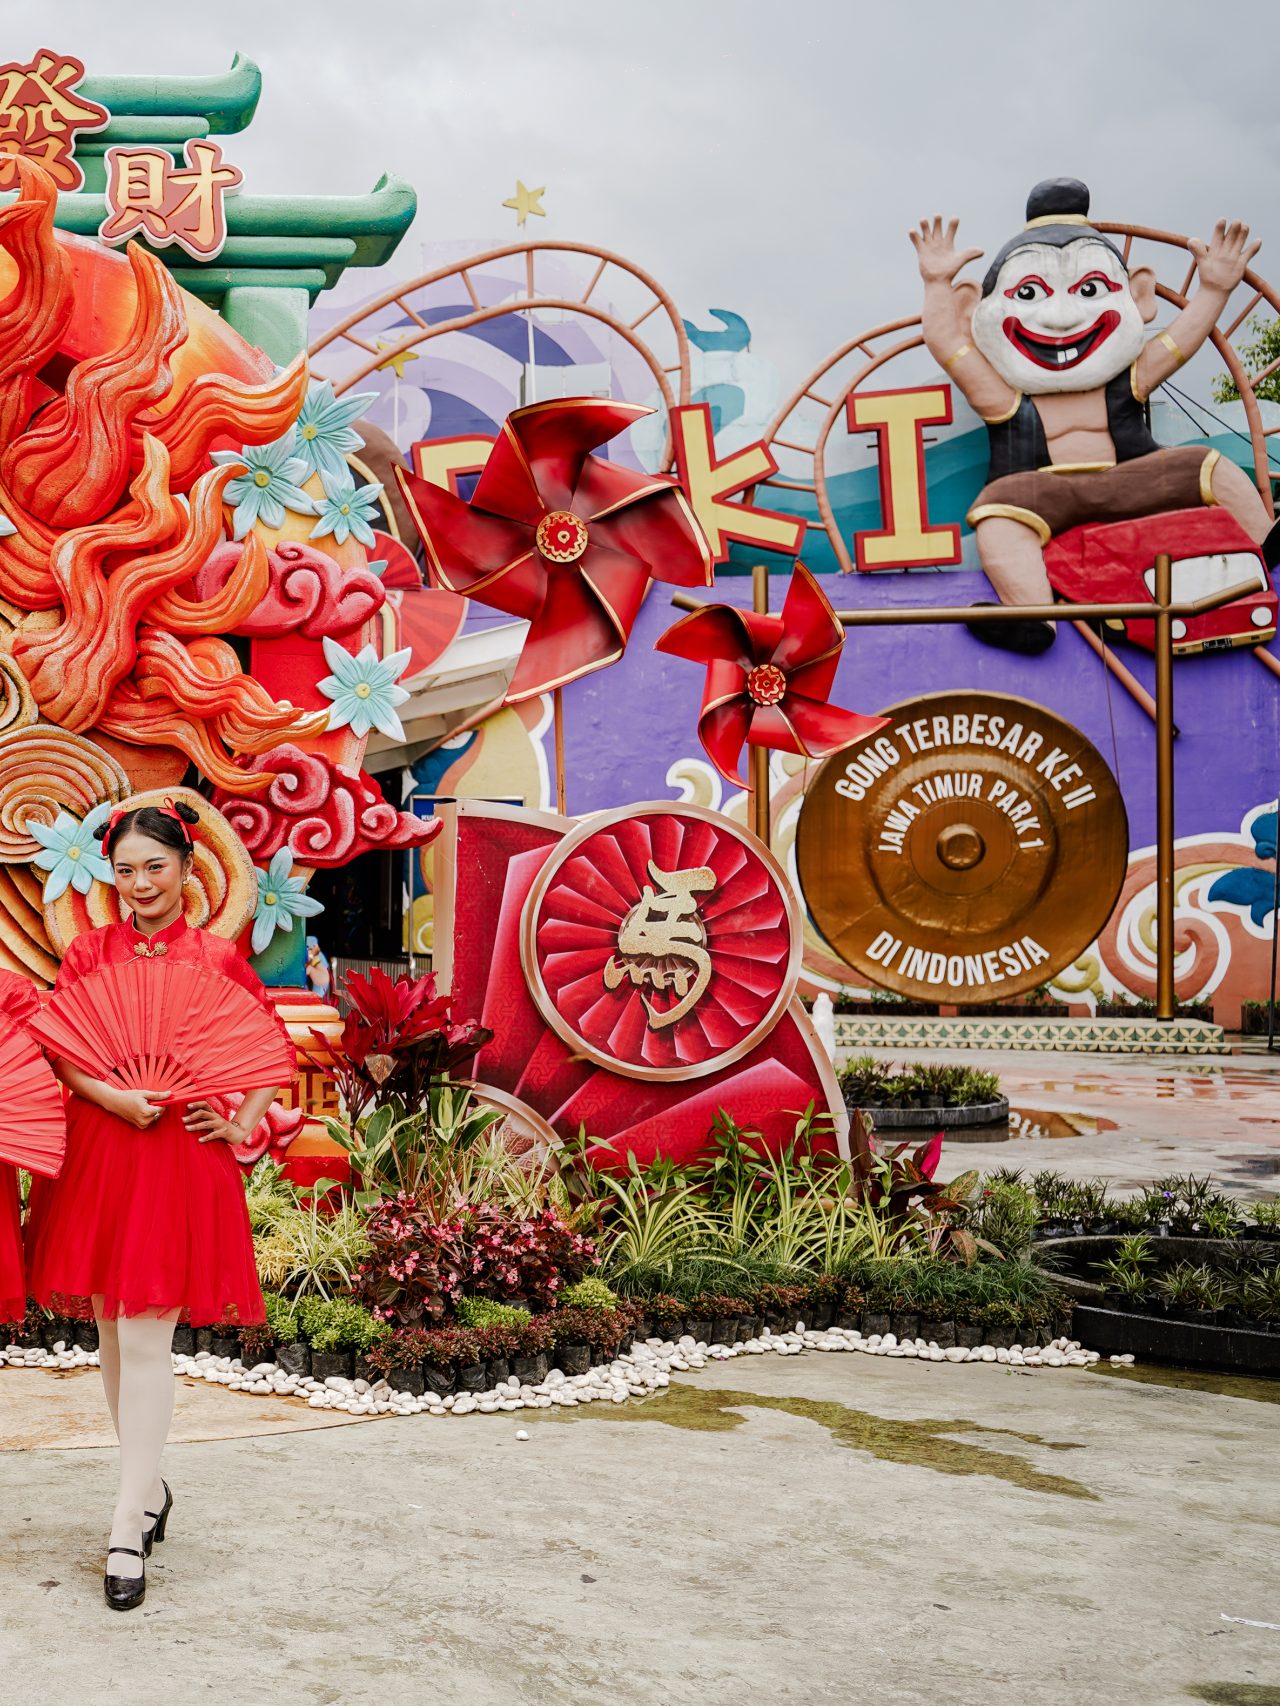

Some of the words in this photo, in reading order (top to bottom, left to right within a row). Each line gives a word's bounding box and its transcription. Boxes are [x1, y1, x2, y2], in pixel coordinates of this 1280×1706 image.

[835, 737, 901, 801] GONG
[895, 714, 1044, 764] TERBESAR
[1036, 747, 1083, 791] KE
[1062, 783, 1097, 810] II
[878, 799, 920, 855] JAWA
[912, 773, 983, 805] TIMUR
[987, 780, 1042, 835] PARK
[1019, 838, 1045, 850] 1
[865, 930, 903, 968] DI
[897, 935, 1050, 987] INDONESIA
